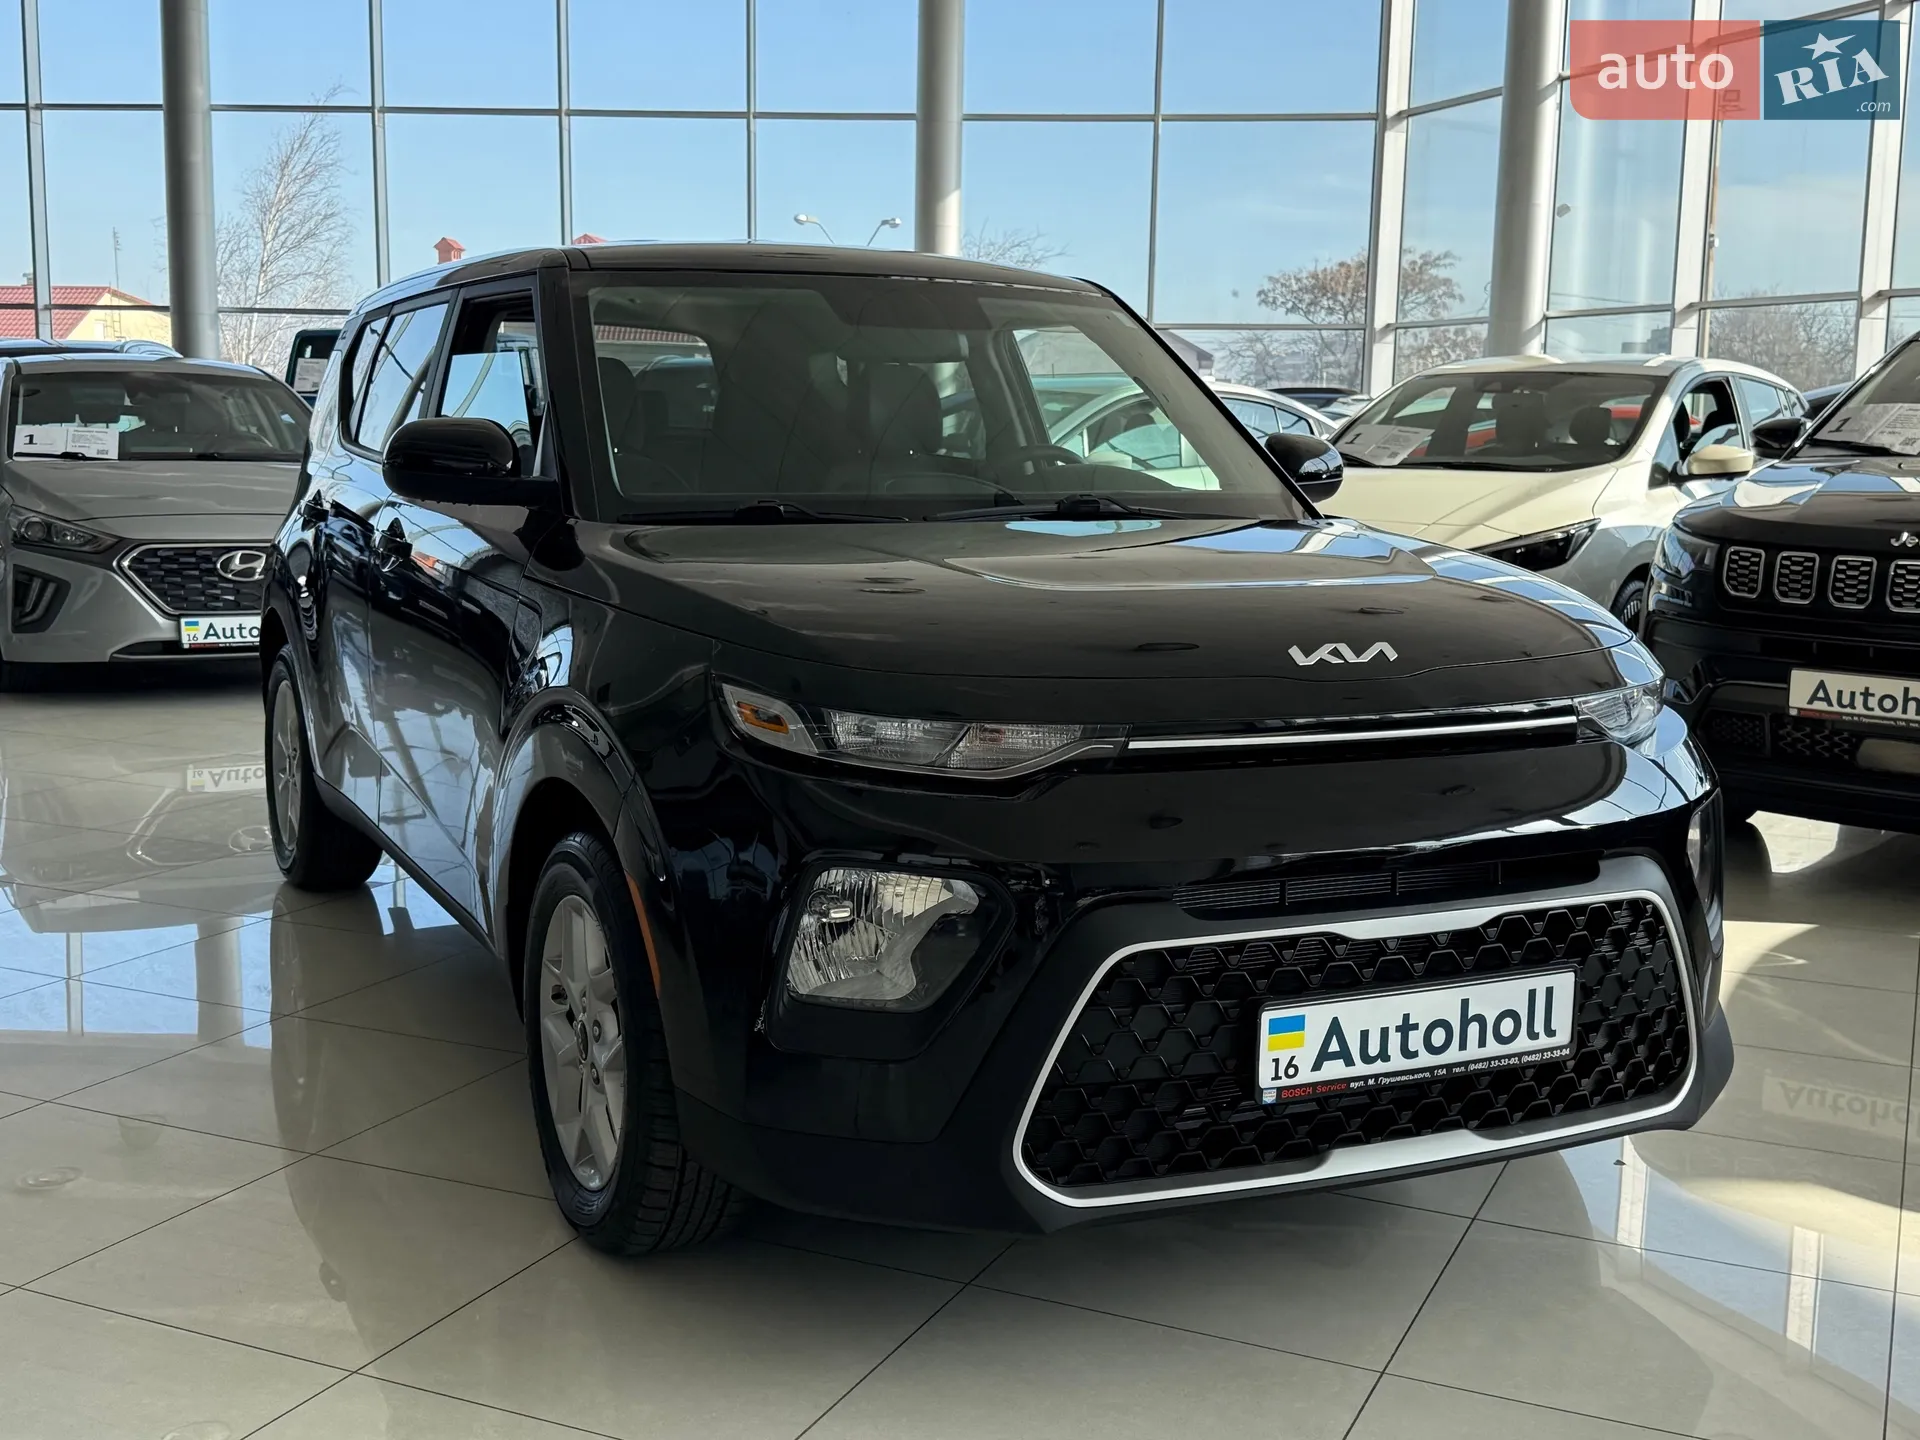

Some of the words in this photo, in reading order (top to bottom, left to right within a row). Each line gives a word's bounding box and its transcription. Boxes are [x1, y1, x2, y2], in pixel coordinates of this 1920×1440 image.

[1890, 531, 1920, 547] Je
[186, 633, 199, 642] 16
[203, 622, 260, 640] Auto
[1287, 641, 1398, 666] KIA
[1310, 986, 1557, 1072] Autoholl
[1270, 1055, 1300, 1081] 16
[1349, 1080, 1366, 1089] вул.
[1468, 1060, 1489, 1072] (0482)
[1521, 1052, 1542, 1064] (0482)
[1542, 1047, 1570, 1060] 33-33-04
[1281, 1086, 1313, 1098] BOSCH
[1316, 1082, 1347, 1093] Service
